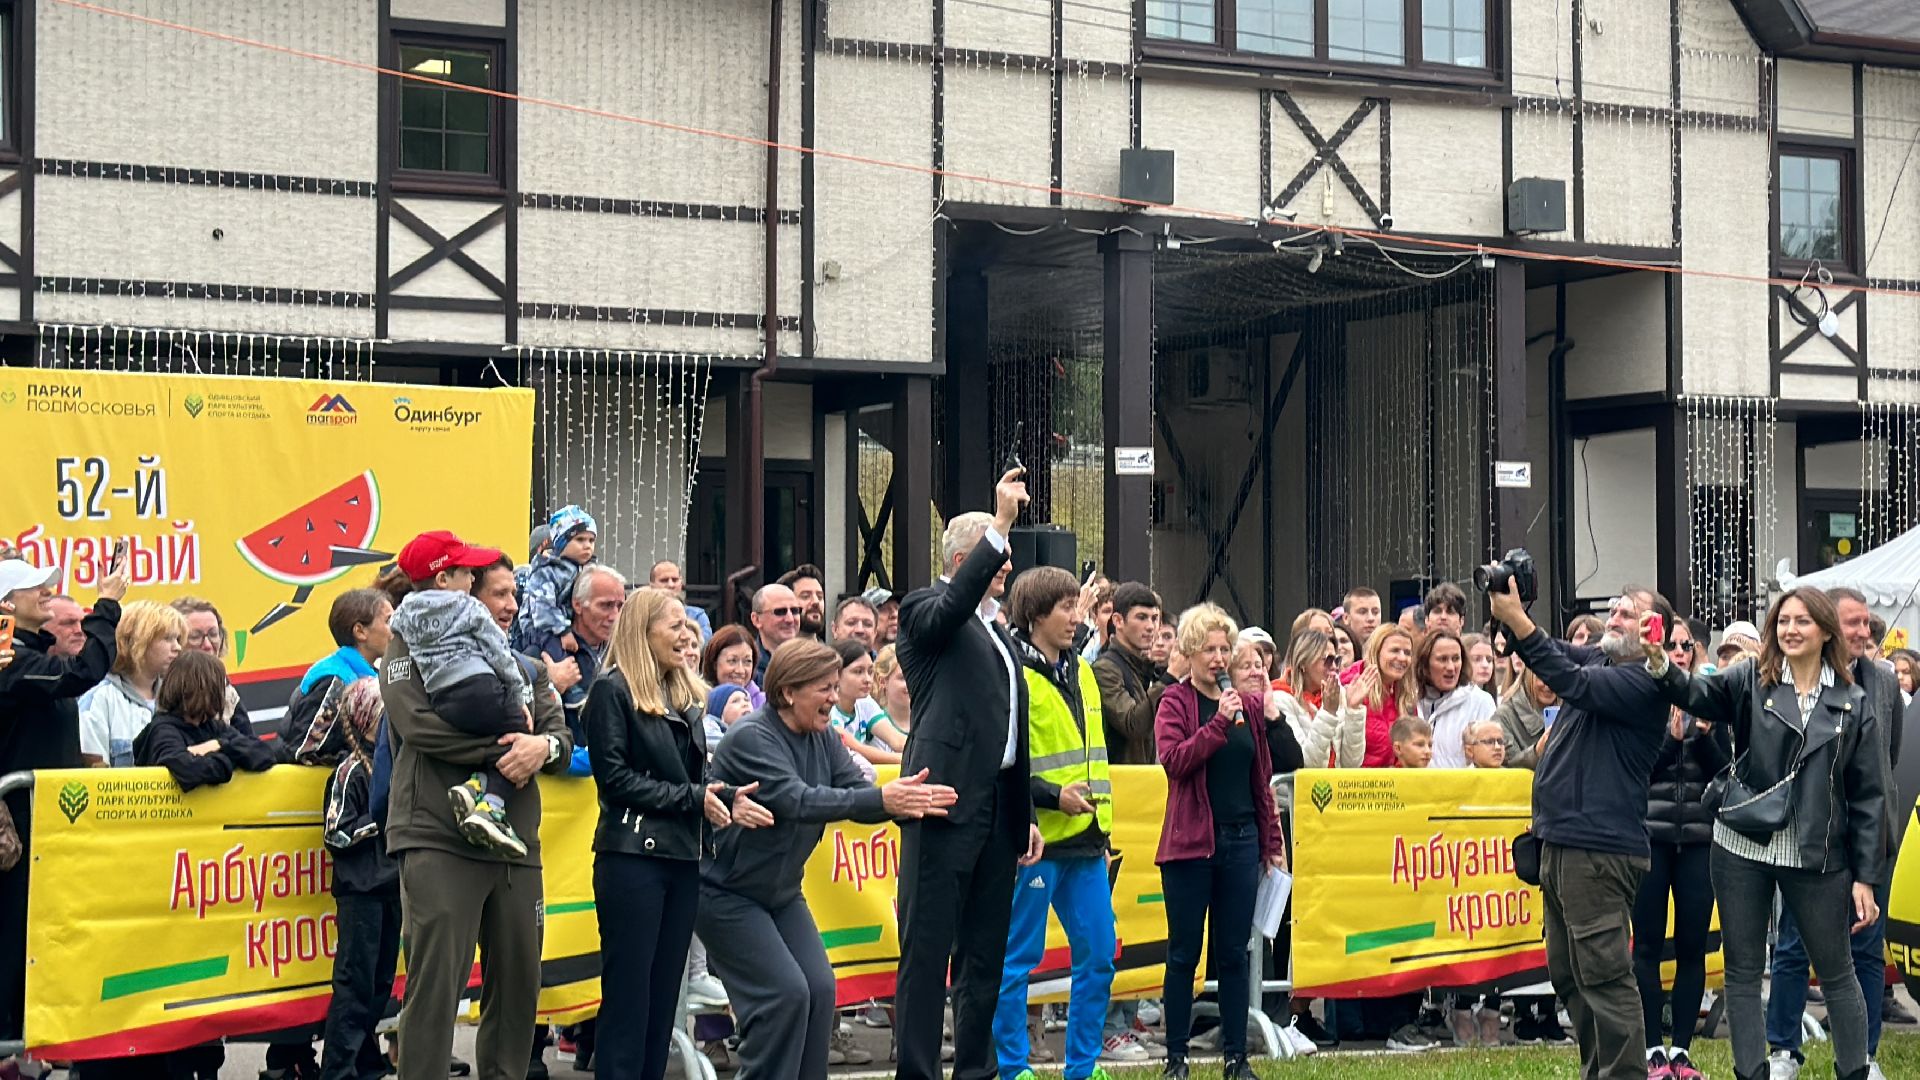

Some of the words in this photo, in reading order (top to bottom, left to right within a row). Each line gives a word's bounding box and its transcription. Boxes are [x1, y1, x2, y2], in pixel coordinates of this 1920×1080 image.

[27, 384, 82, 398] ПАРКИ
[27, 399, 156, 416] ПОДМОСКОВЬЯ
[306, 413, 357, 425] marsport
[394, 405, 482, 427] Одинбург
[0, 520, 200, 595] бузный
[97, 780, 180, 792] ОДИНЦОВСКИЙ
[1337, 780, 1395, 790] ОДИНЦОВСКИЙ
[96, 795, 125, 806] ПАРК
[127, 794, 183, 806] КУЛЬТУРЫ,
[1337, 791, 1356, 800] ПАРК
[96, 809, 137, 820] СПОРТА
[140, 810, 148, 819] И
[150, 807, 193, 820] ОТДЫХА
[1336, 802, 1366, 811] СПОРТА
[1367, 802, 1373, 811] И
[1374, 802, 1406, 812] ОТДЫХА
[1392, 831, 1516, 892] Арбузны
[1447, 889, 1532, 941] кросс
[246, 912, 338, 978] крос
